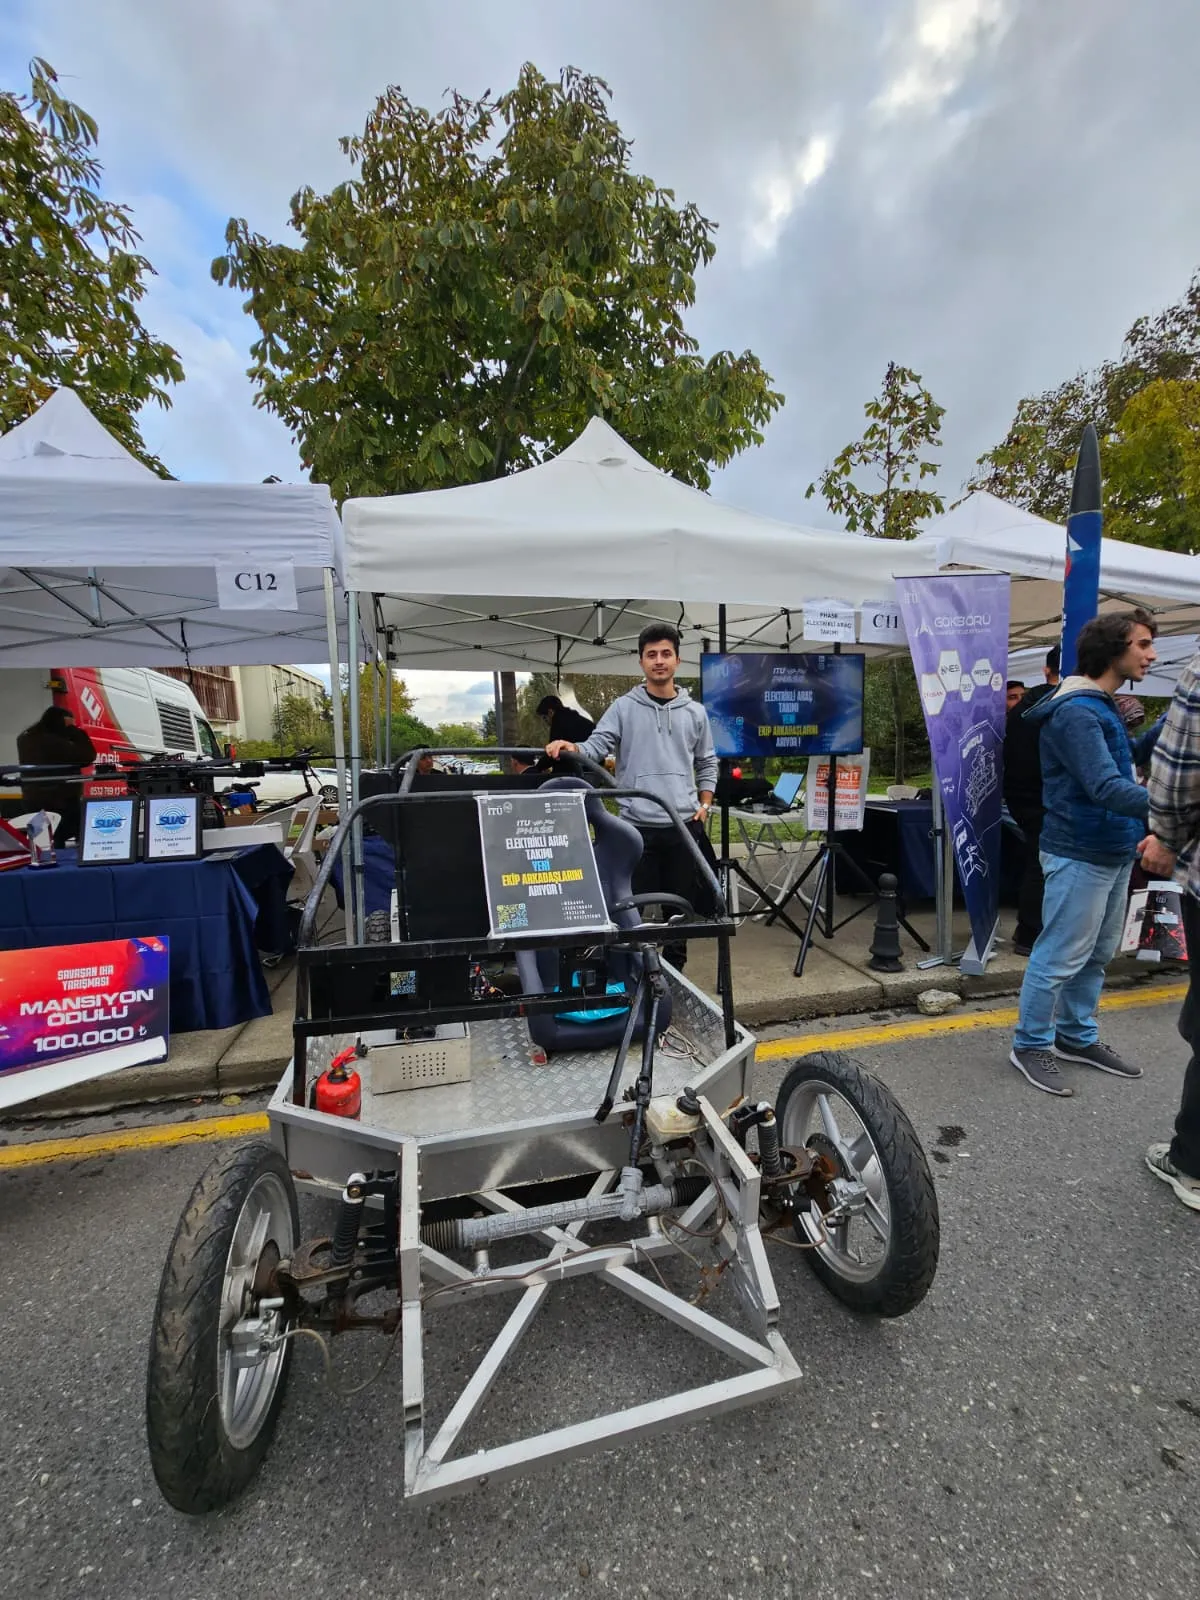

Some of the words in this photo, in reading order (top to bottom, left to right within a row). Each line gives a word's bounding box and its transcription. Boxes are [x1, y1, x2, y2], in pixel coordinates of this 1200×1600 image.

[234, 572, 278, 591] C12
[873, 613, 898, 629] C11
[515, 825, 555, 835] PHASE
[505, 835, 547, 850] ELEKTRİKLİ
[548, 834, 569, 848] ARAÇ
[525, 847, 553, 861] TAKIMI
[501, 873, 521, 887] EKİP
[522, 868, 584, 885] ARKADAŞLARINI
[528, 884, 558, 897] ARIYOR
[33, 1026, 134, 1053] 100.000
